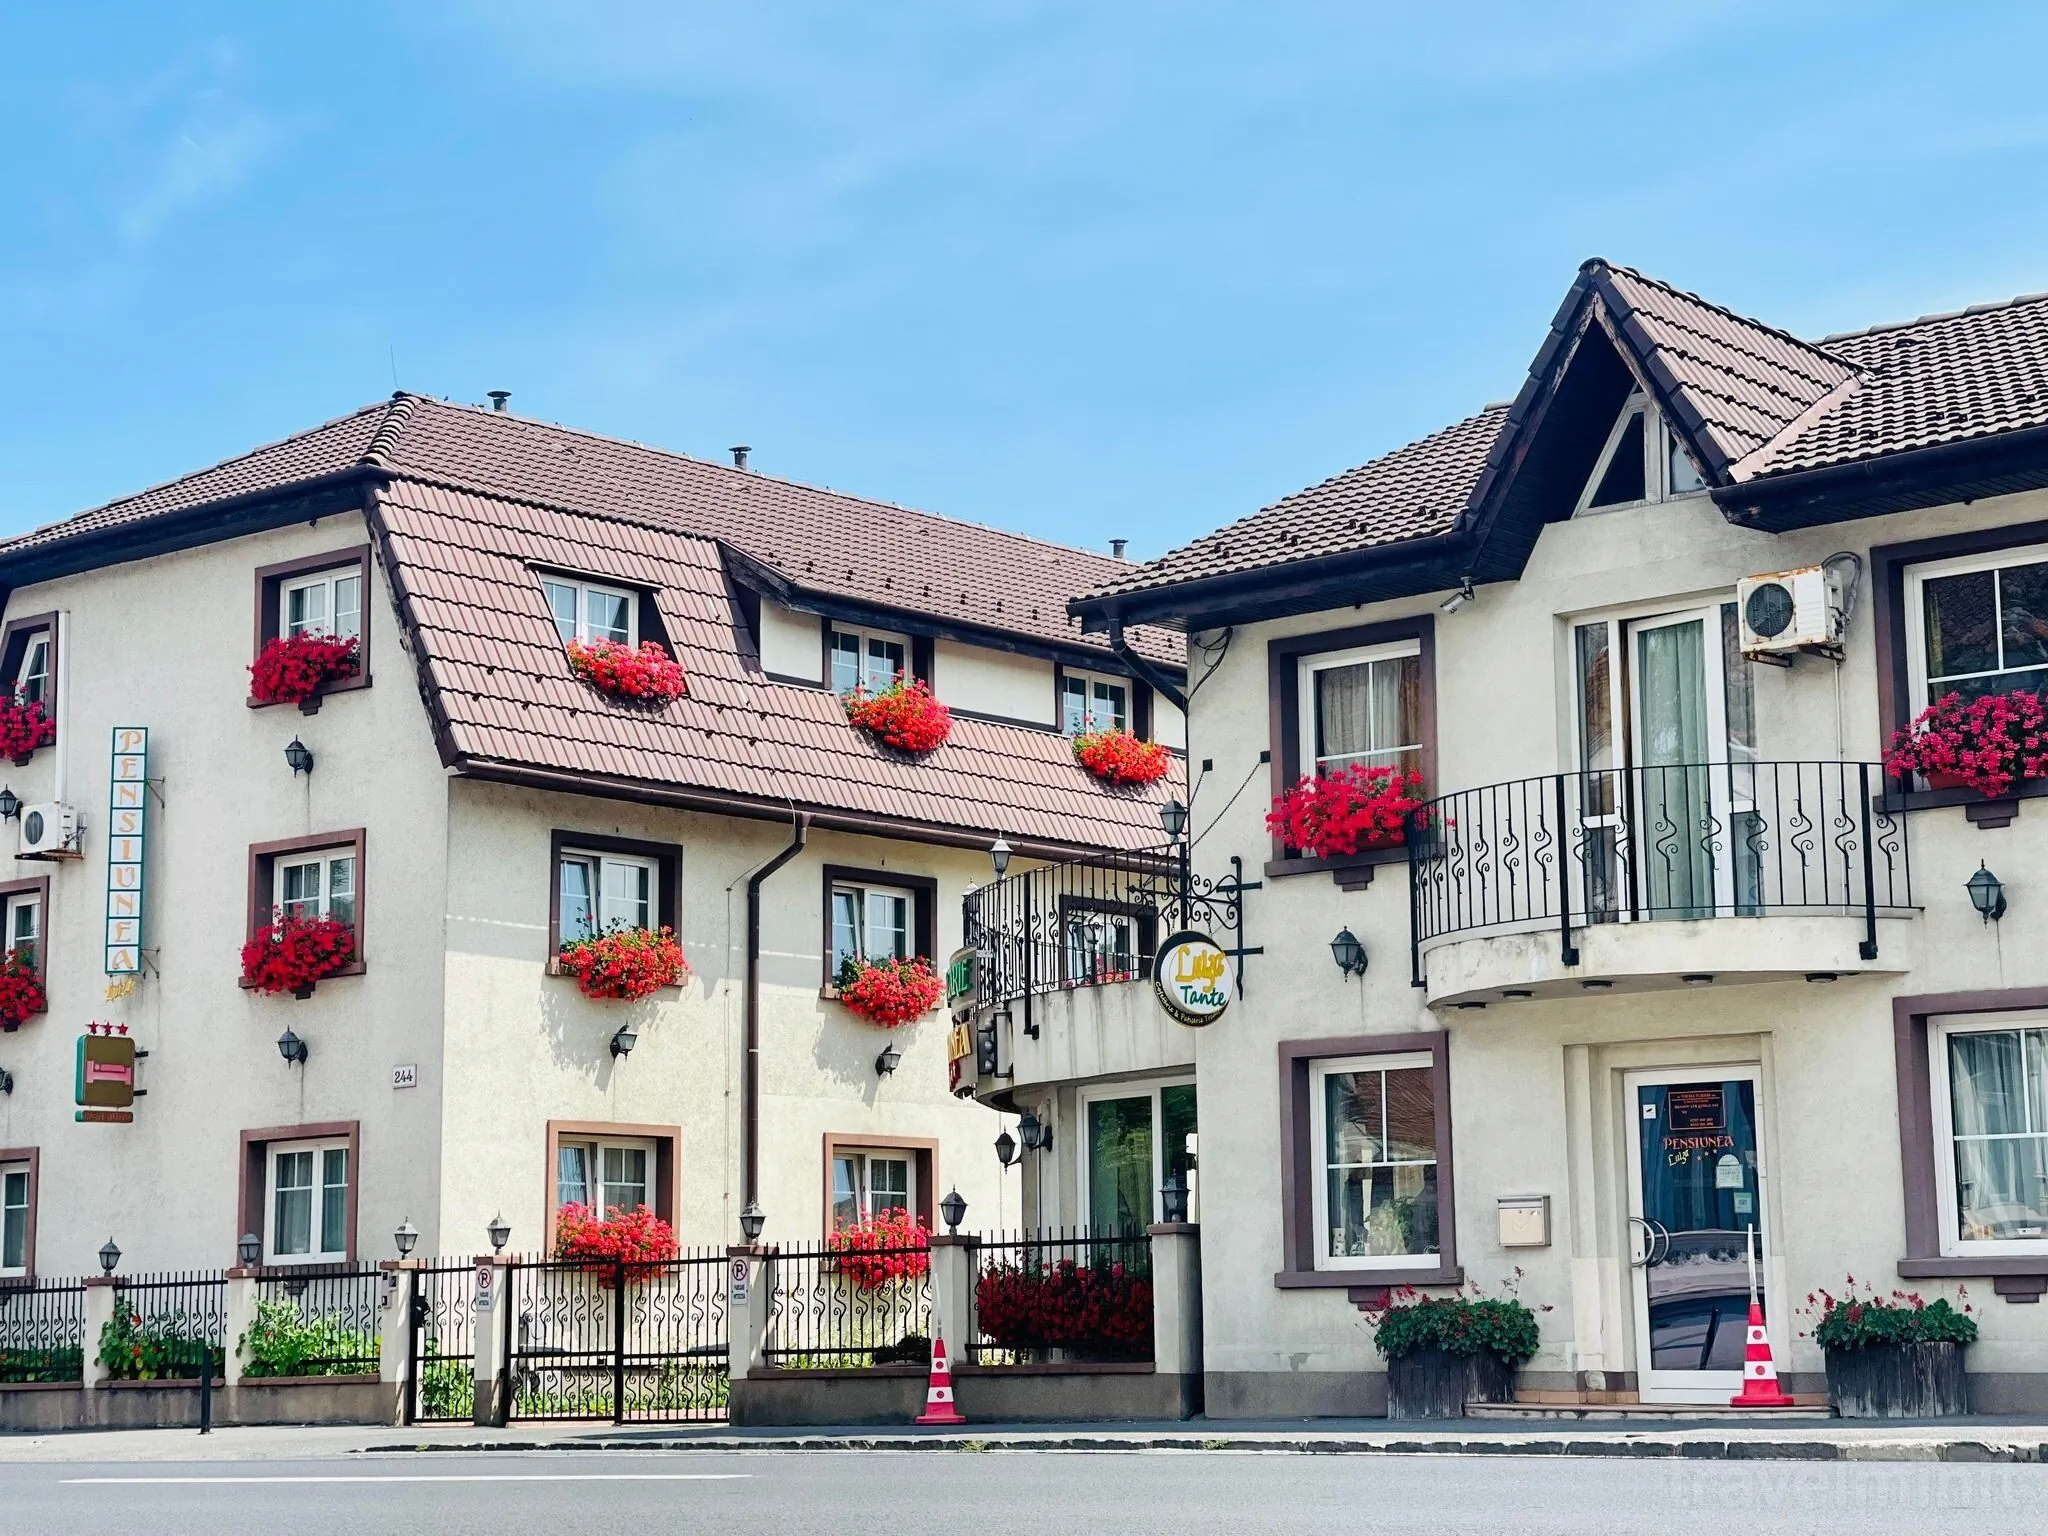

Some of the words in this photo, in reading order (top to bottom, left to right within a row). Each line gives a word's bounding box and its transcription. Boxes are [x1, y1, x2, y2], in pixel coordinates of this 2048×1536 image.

[111, 730, 142, 970] PENSIUNEA
[1180, 985, 1226, 1006] Tante
[394, 1069, 413, 1084] 244
[1663, 1135, 1734, 1149] PENSIUNEA
